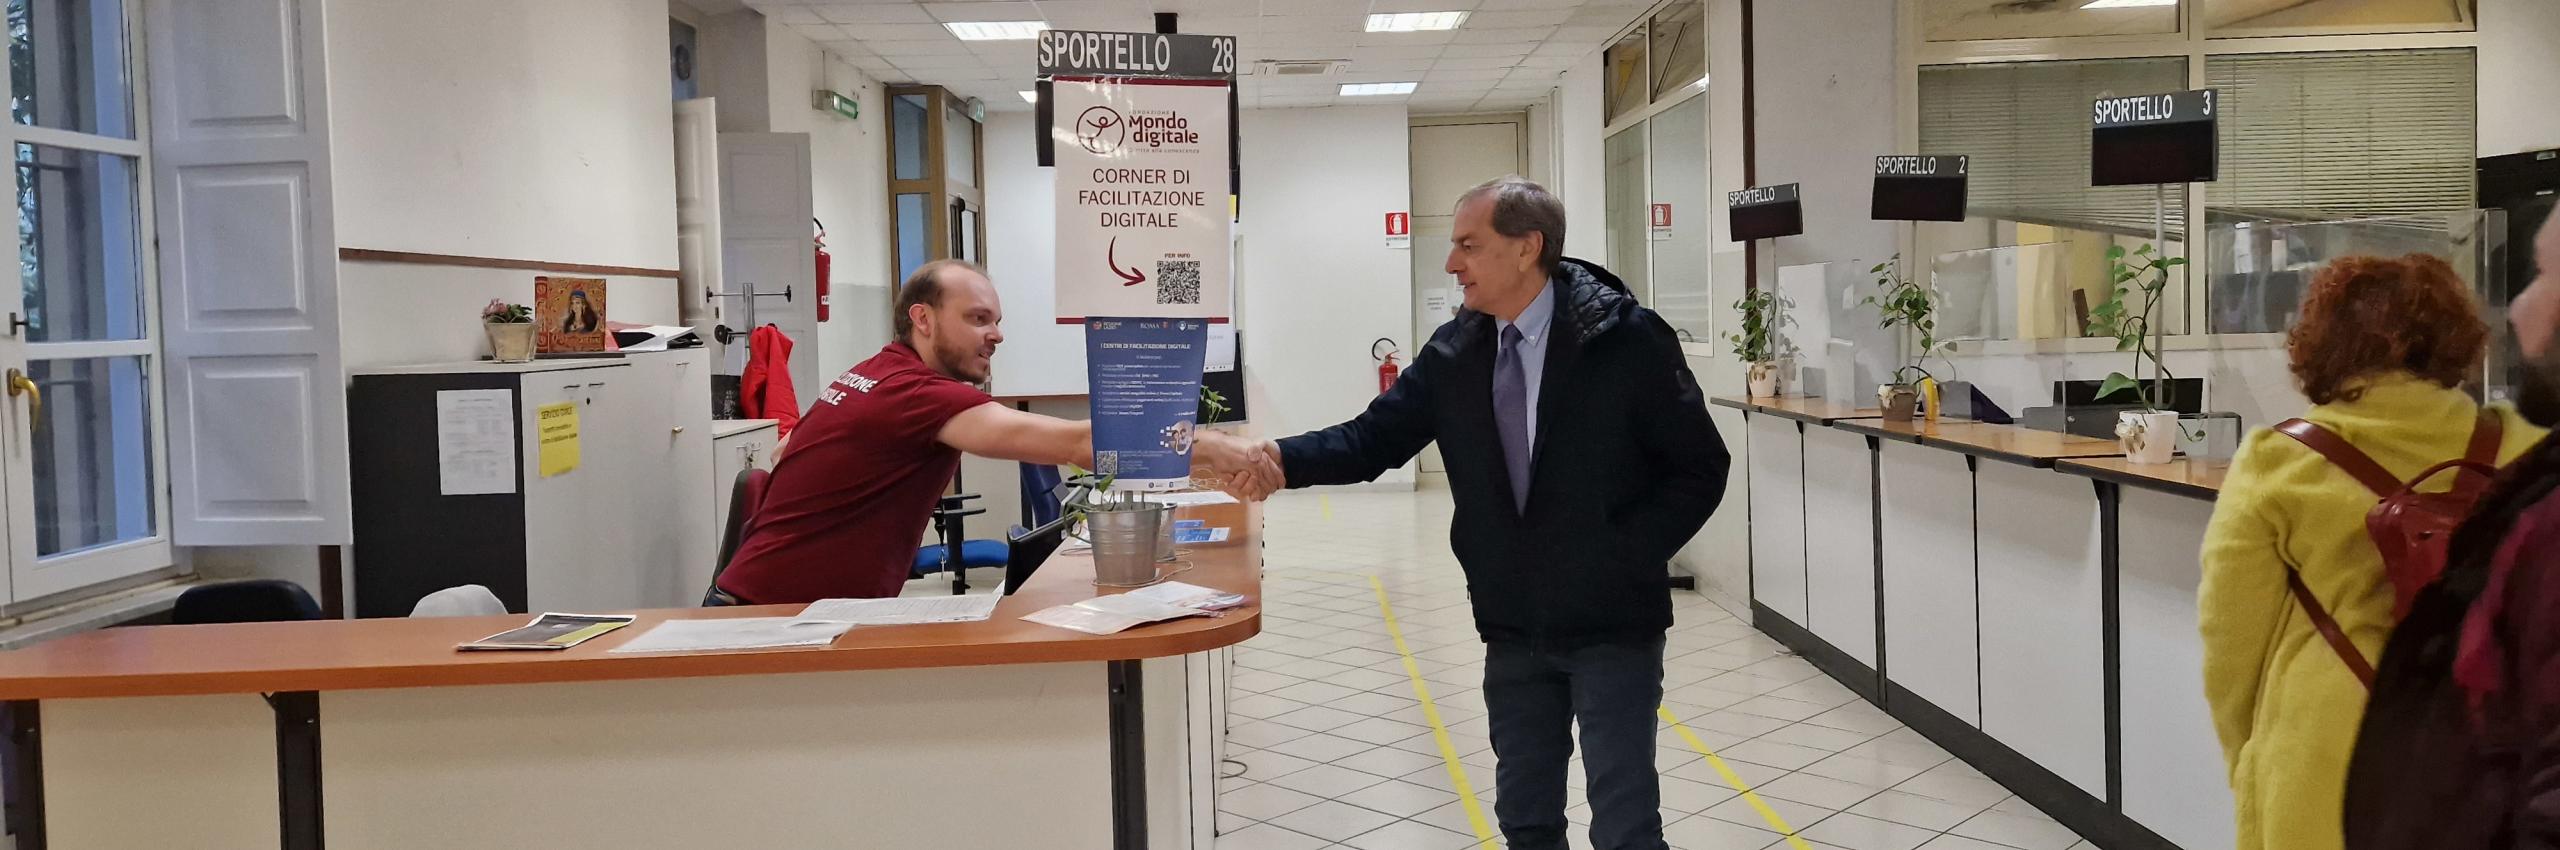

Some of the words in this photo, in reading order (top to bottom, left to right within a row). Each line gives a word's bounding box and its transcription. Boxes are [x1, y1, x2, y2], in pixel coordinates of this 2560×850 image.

[1039, 30, 1170, 72] SPORTELLO
[1211, 37, 1234, 74] 28
[2094, 94, 2173, 124] SPORTELLO
[2202, 90, 2211, 116] 3
[1129, 111, 1187, 129] Mondo
[1133, 128, 1199, 147] digitale
[1876, 156, 1937, 175] SPORTELLO
[1958, 156, 1966, 174] 2
[1092, 168, 1166, 184] CORNER
[1173, 169, 1190, 184] DI
[1079, 190, 1205, 206] FACILITAZIONE
[1729, 187, 1775, 207] SPORTELLO
[1792, 183, 1797, 199] 1
[1101, 212, 1178, 228] DIGITALE
